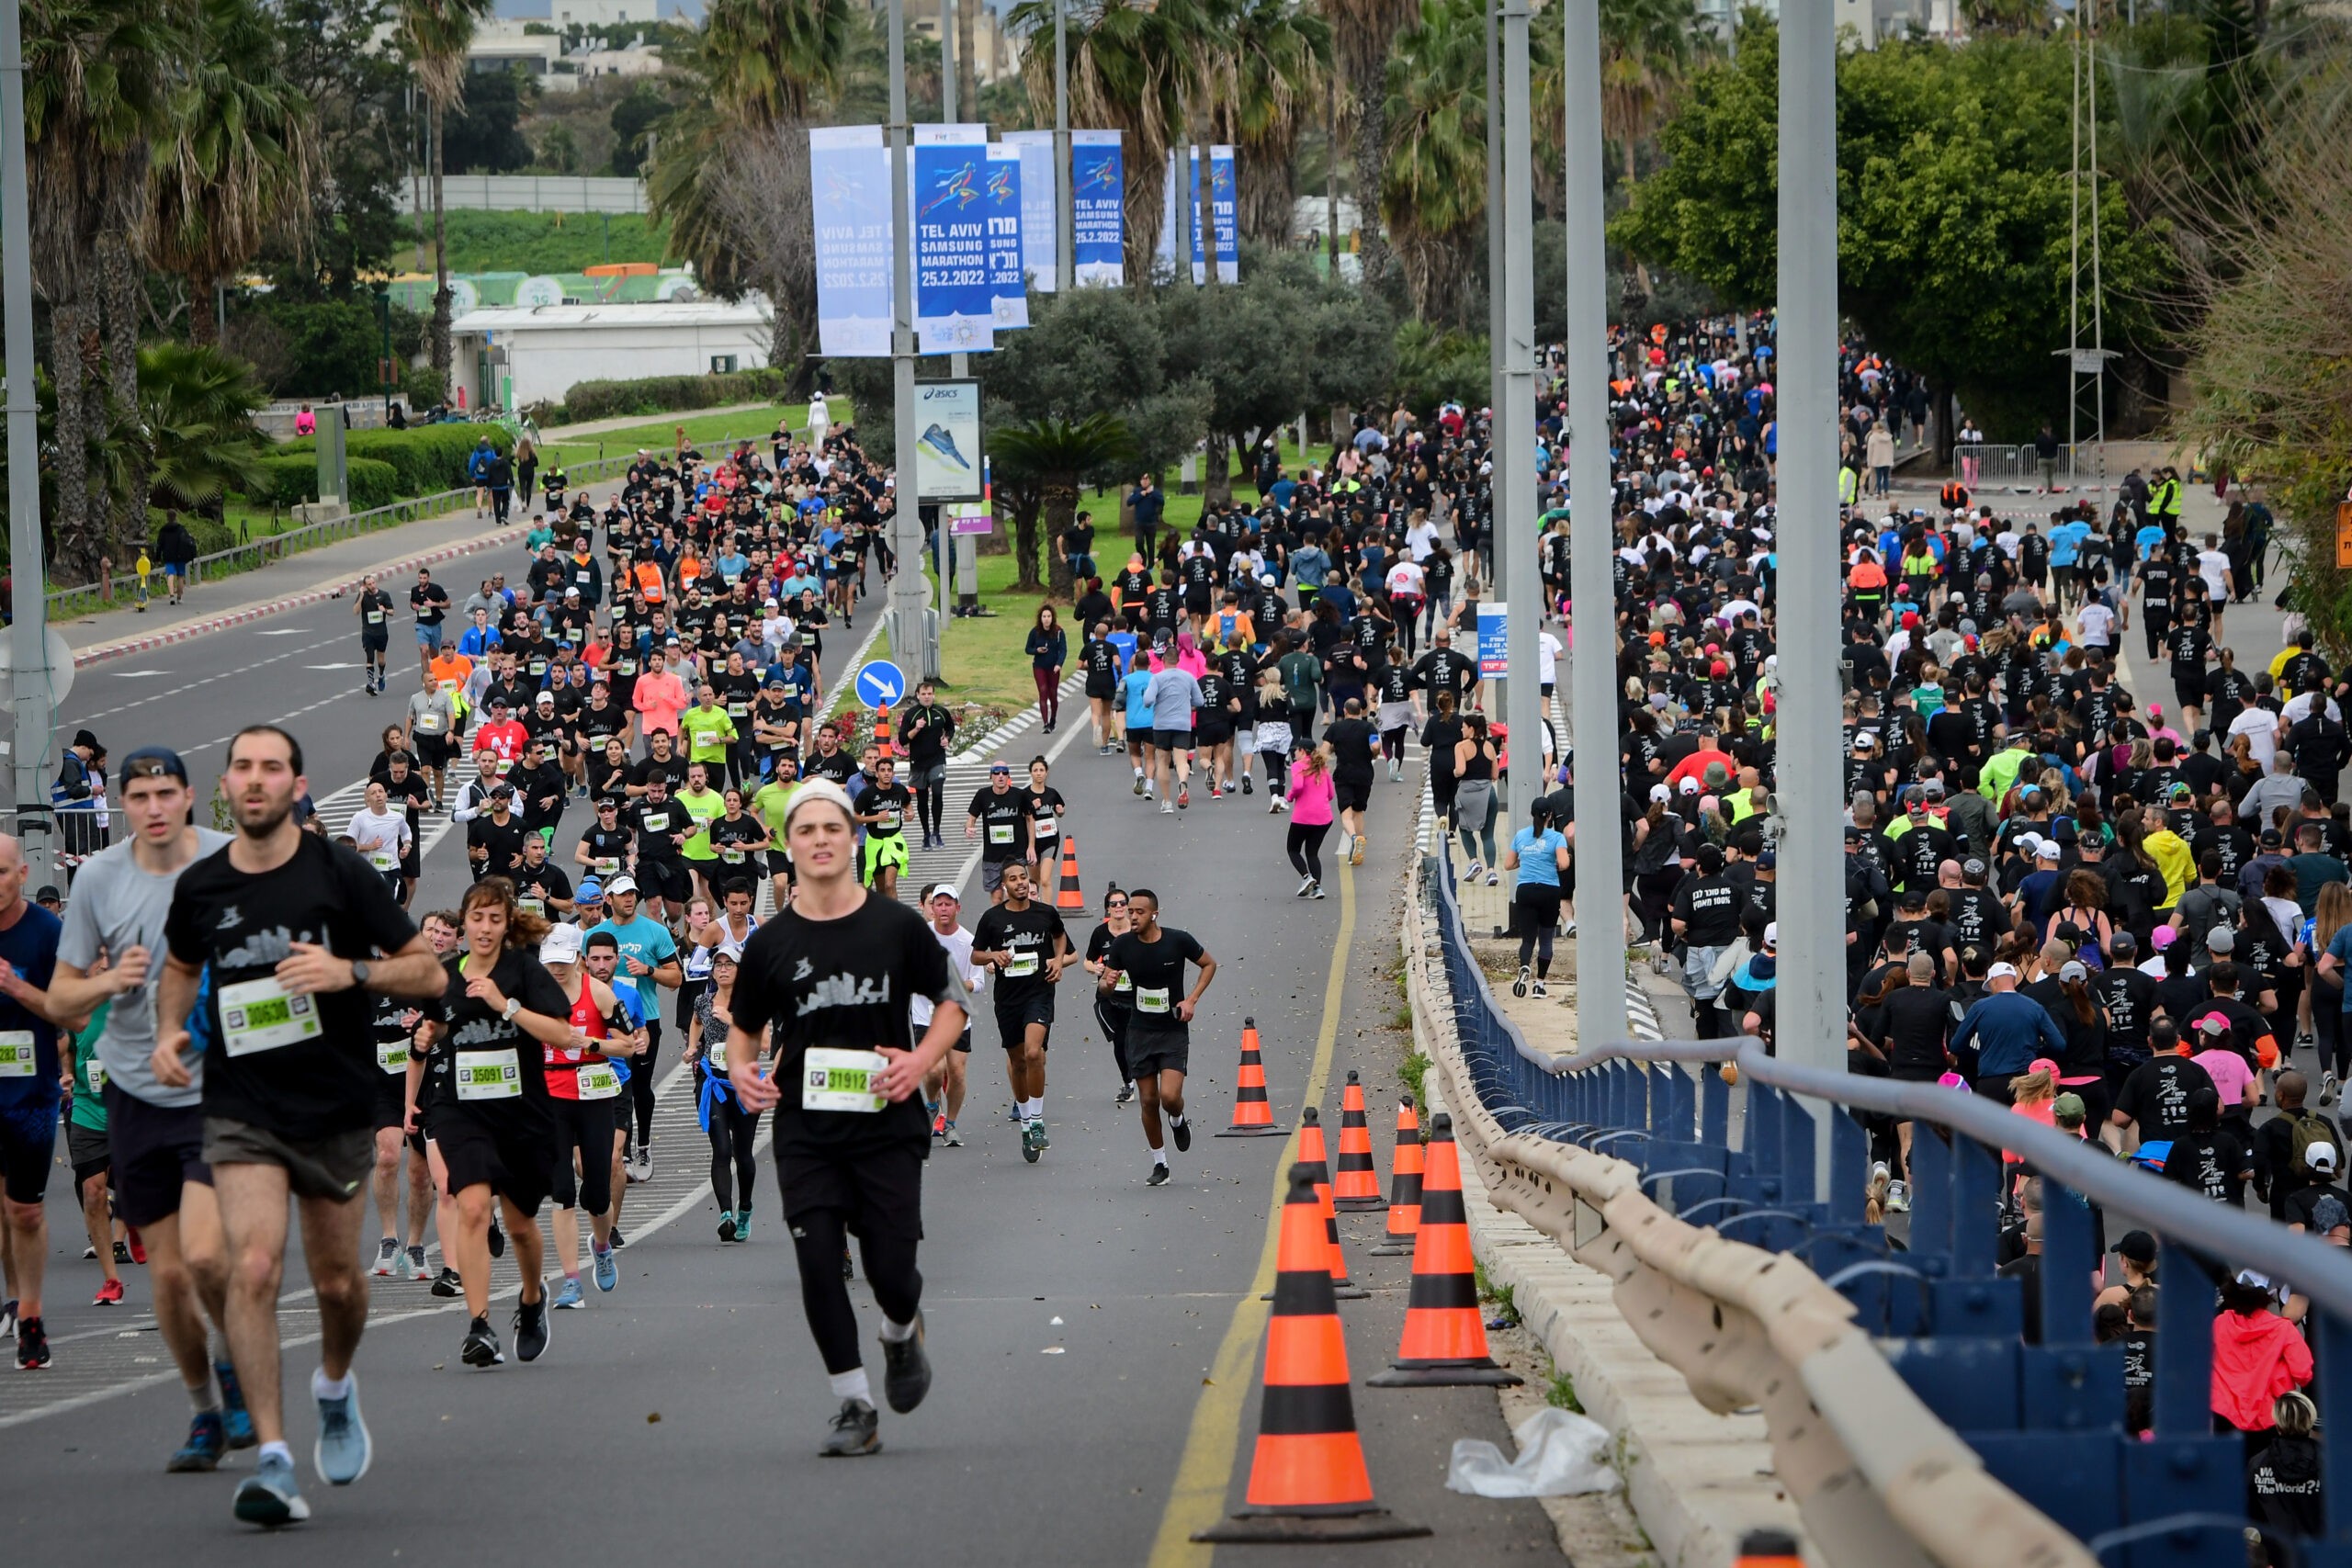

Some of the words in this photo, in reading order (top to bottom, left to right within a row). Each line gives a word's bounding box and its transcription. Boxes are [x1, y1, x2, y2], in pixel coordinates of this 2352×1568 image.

[1075, 199, 1092, 210] TEL
[1095, 199, 1119, 210] AVIV
[1075, 210, 1119, 220] SAMSUNG
[921, 224, 944, 238] TEL
[949, 223, 982, 238] AVIV
[1075, 220, 1119, 230] MARATHON
[1075, 231, 1120, 243] 25.2.2022
[922, 239, 982, 254] SAMSUNG
[922, 254, 984, 267] MARATHON
[922, 270, 985, 287] 25.2.2022
[935, 389, 958, 398] asics
[1692, 889, 1703, 901] לבן
[1704, 888, 1719, 897] סוכר
[1713, 897, 1731, 906] 100%
[472, 1068, 502, 1082] 35091
[828, 1072, 866, 1089] 31912
[2257, 1484, 2276, 1495] The
